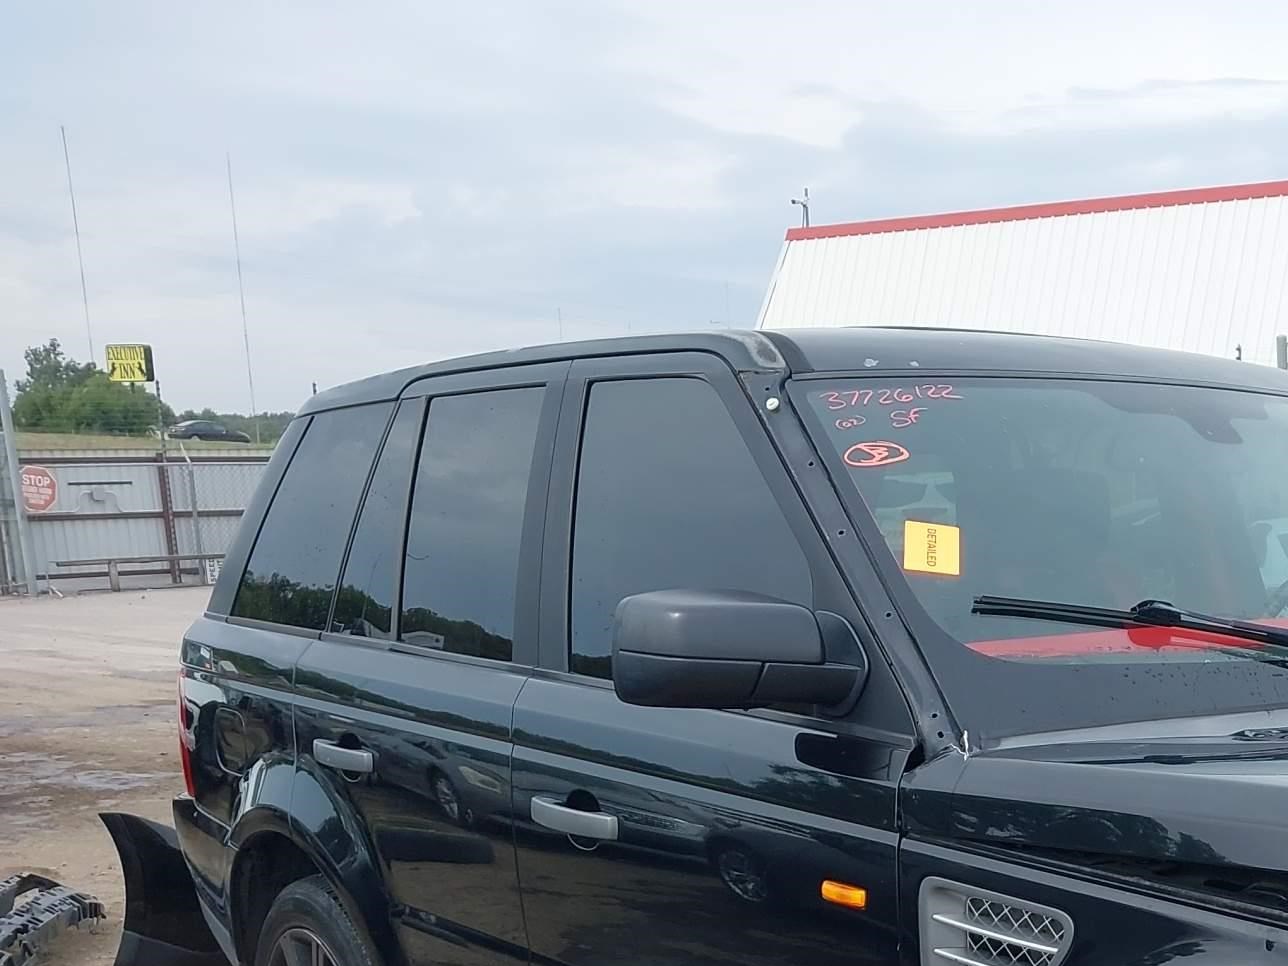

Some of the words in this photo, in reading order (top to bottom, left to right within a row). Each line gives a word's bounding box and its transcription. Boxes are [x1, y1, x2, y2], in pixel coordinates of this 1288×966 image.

[108, 346, 144, 360] EXECUTIVE
[119, 363, 136, 379] INN
[819, 384, 964, 410] 37726122
[22, 474, 51, 487] STOP
[926, 528, 937, 567] DETAILED
